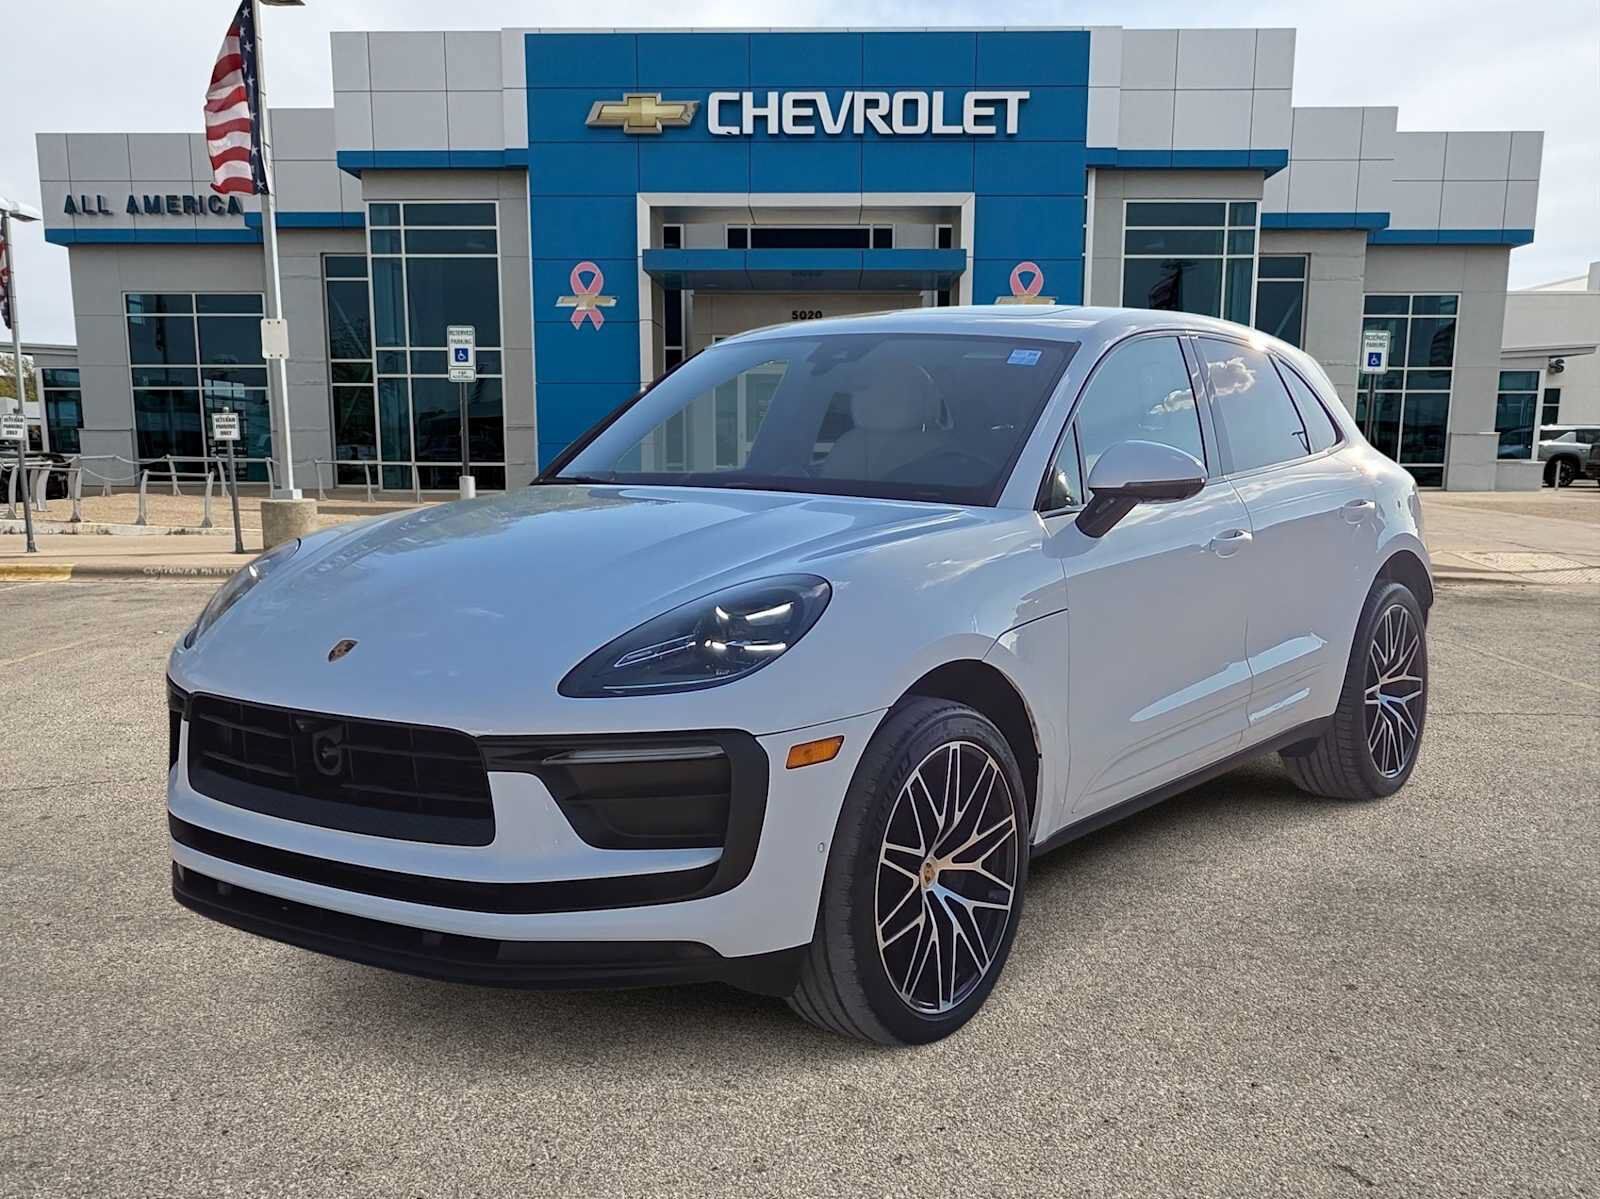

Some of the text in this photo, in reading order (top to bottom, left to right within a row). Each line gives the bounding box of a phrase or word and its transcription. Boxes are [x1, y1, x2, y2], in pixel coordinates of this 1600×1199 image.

[707, 90, 1031, 135] CHEVROLET
[63, 194, 243, 215] ALL AMERICA
[791, 310, 823, 320] 5020
